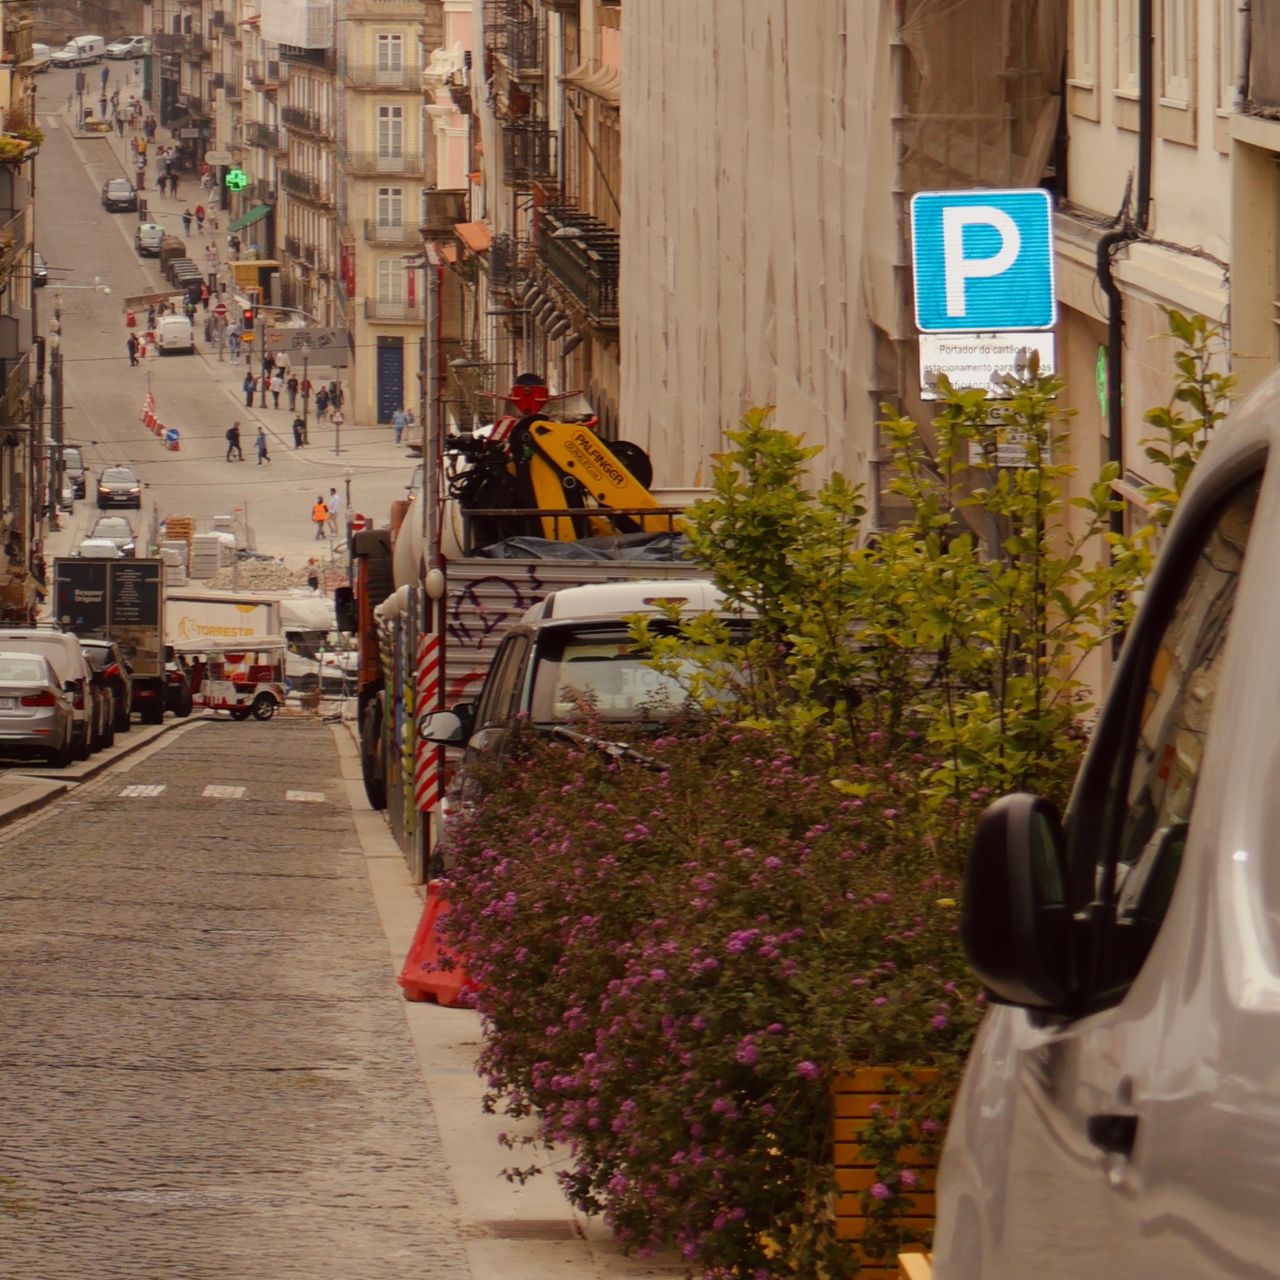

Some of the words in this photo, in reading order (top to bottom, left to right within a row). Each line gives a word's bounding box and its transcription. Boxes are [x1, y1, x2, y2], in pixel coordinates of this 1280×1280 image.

[942, 206, 1020, 317] P
[939, 344, 977, 354] Portador
[979, 344, 990, 354] do
[923, 363, 992, 372] estacionamento
[575, 433, 625, 486] PALFINGER
